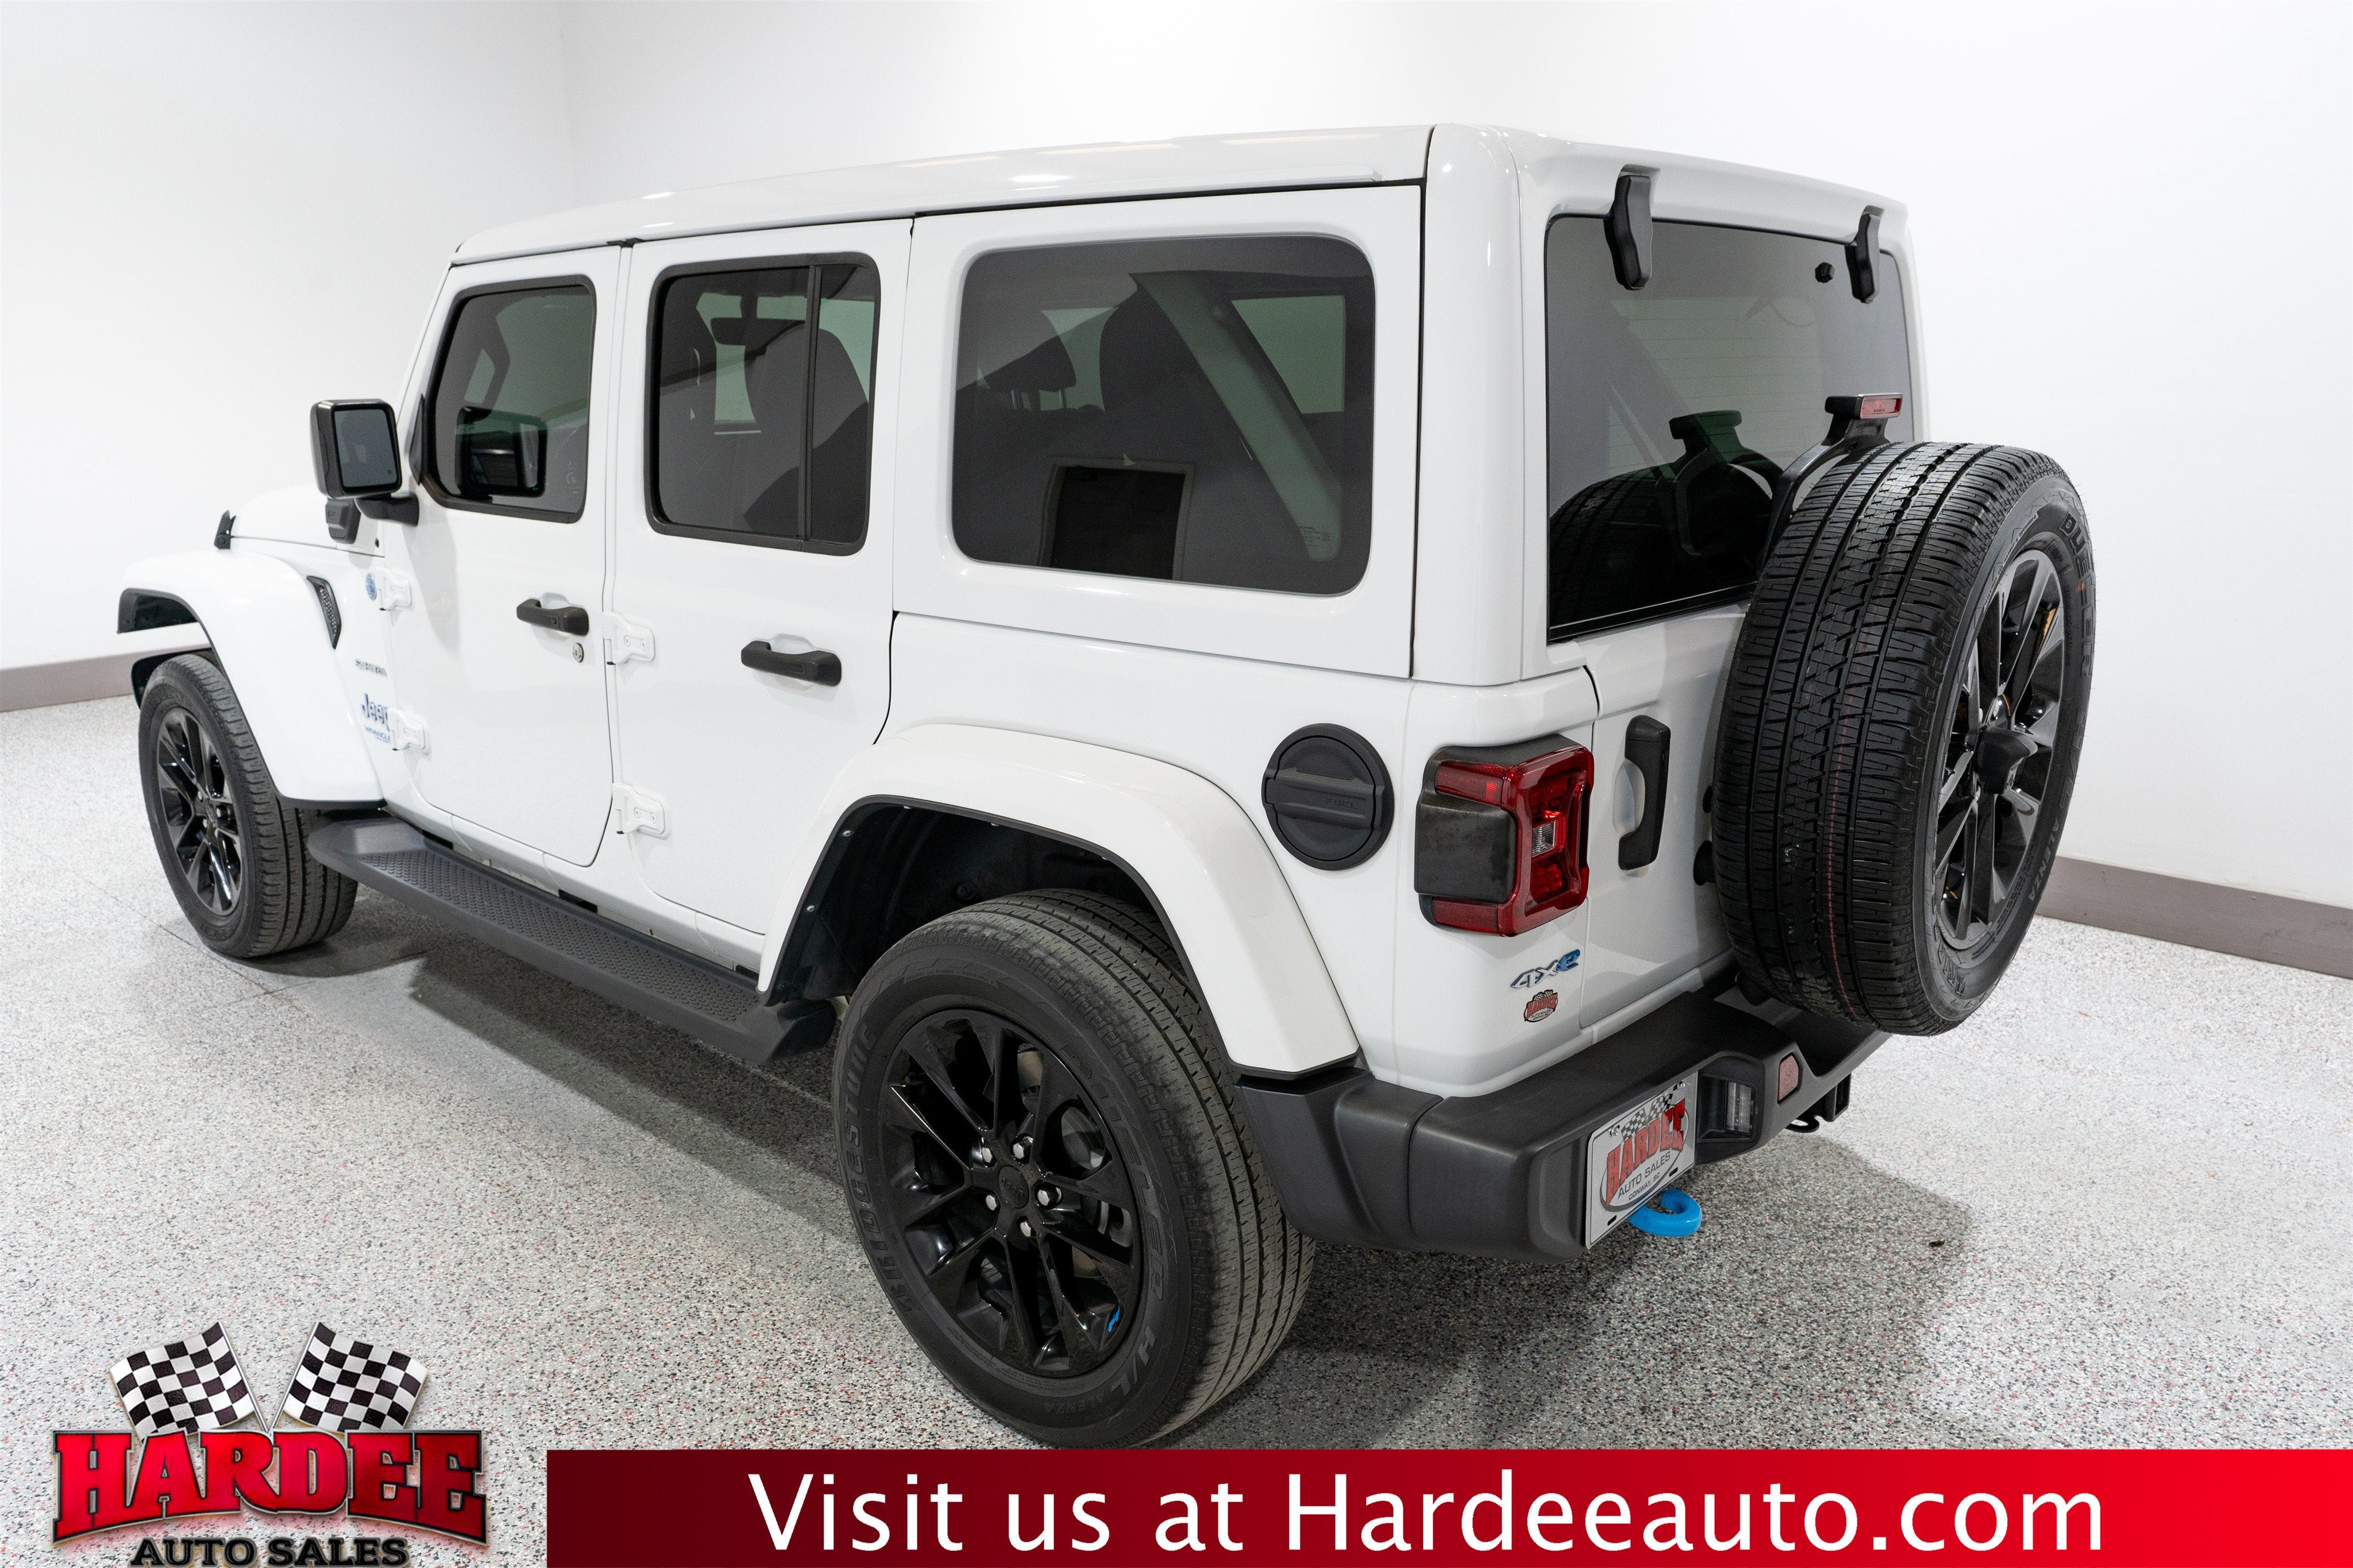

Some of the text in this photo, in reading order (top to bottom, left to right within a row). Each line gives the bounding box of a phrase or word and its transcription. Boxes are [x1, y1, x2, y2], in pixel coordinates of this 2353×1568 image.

[1325, 797, 1359, 810] FUEL
[842, 1025, 912, 1312] BRIDGESTONE
[1606, 1098, 1685, 1206] HARDEE
[1618, 1151, 1671, 1199] AUTO SALES
[1629, 1172, 1661, 1200] CONWAY, SC
